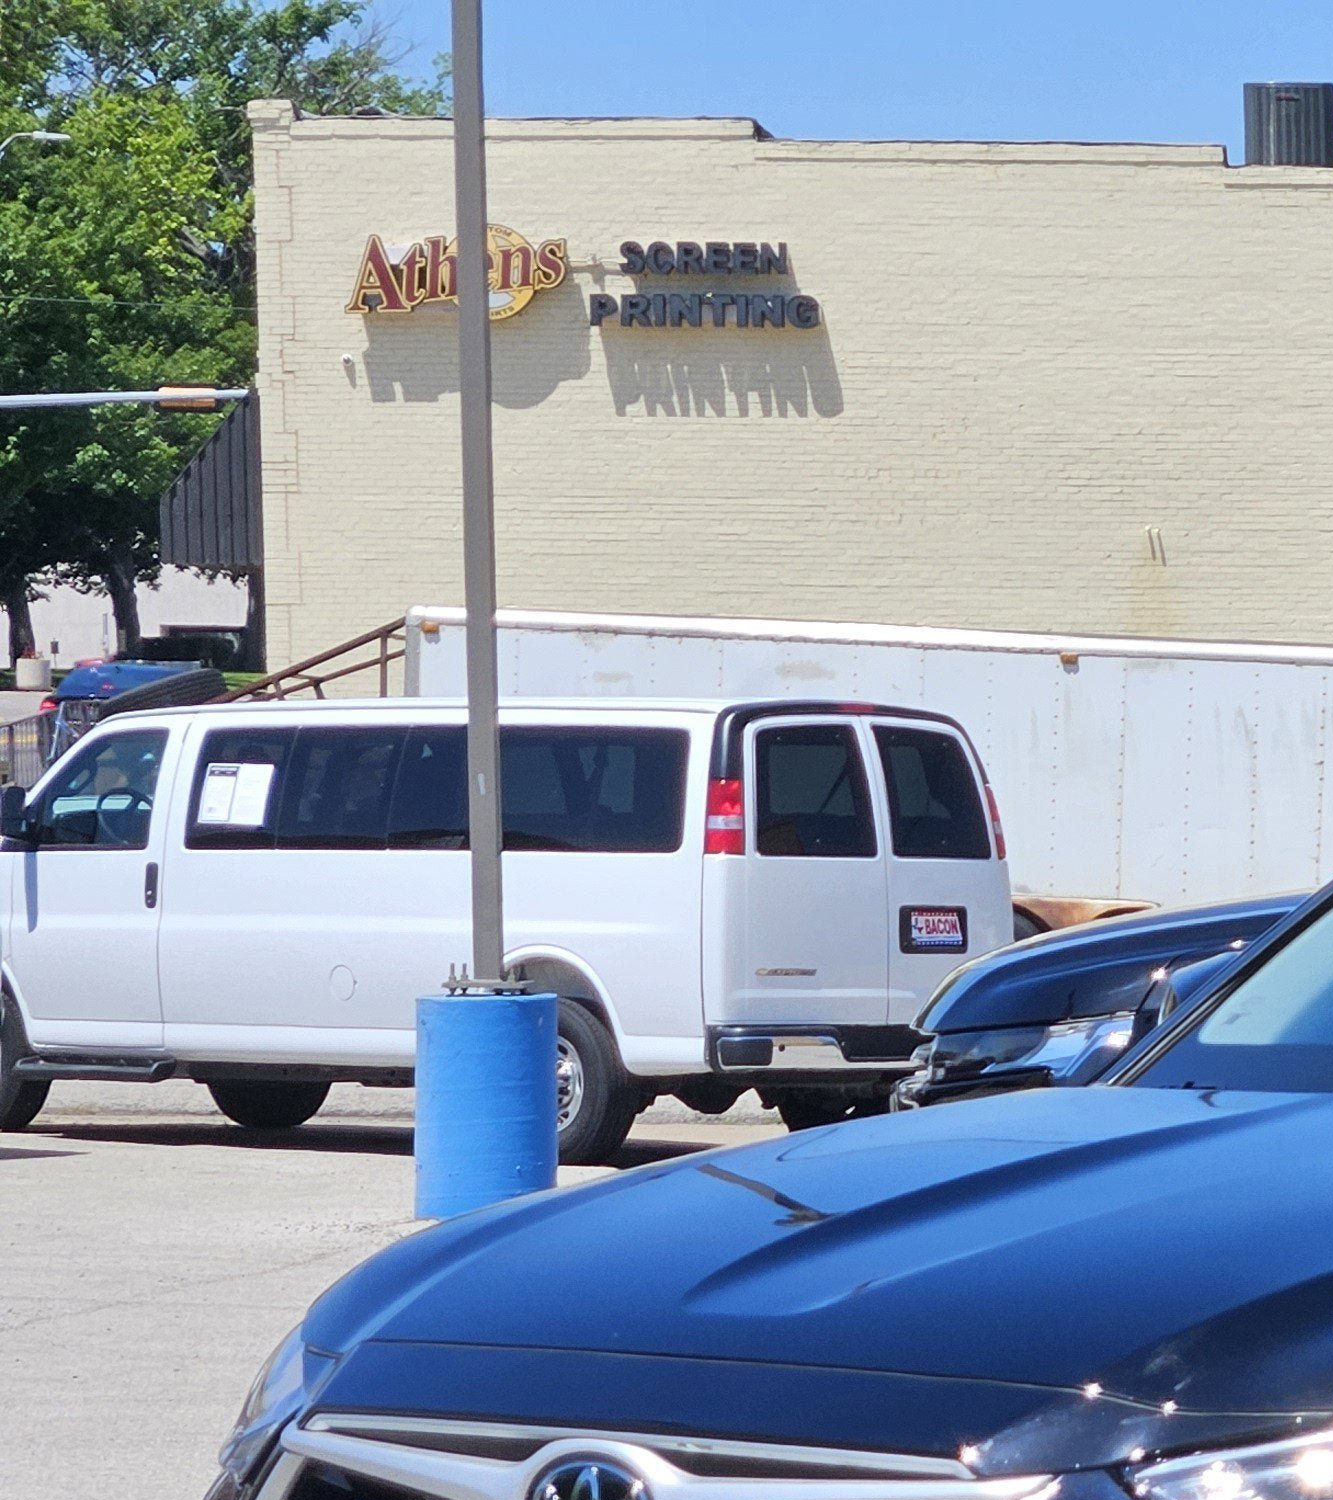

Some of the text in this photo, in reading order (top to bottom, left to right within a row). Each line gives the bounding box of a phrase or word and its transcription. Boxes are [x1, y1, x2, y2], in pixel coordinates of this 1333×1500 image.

[344, 235, 566, 313] Athns
[620, 241, 788, 275] SCREEN
[590, 294, 820, 328] PRINTING
[925, 918, 958, 934] BACON
